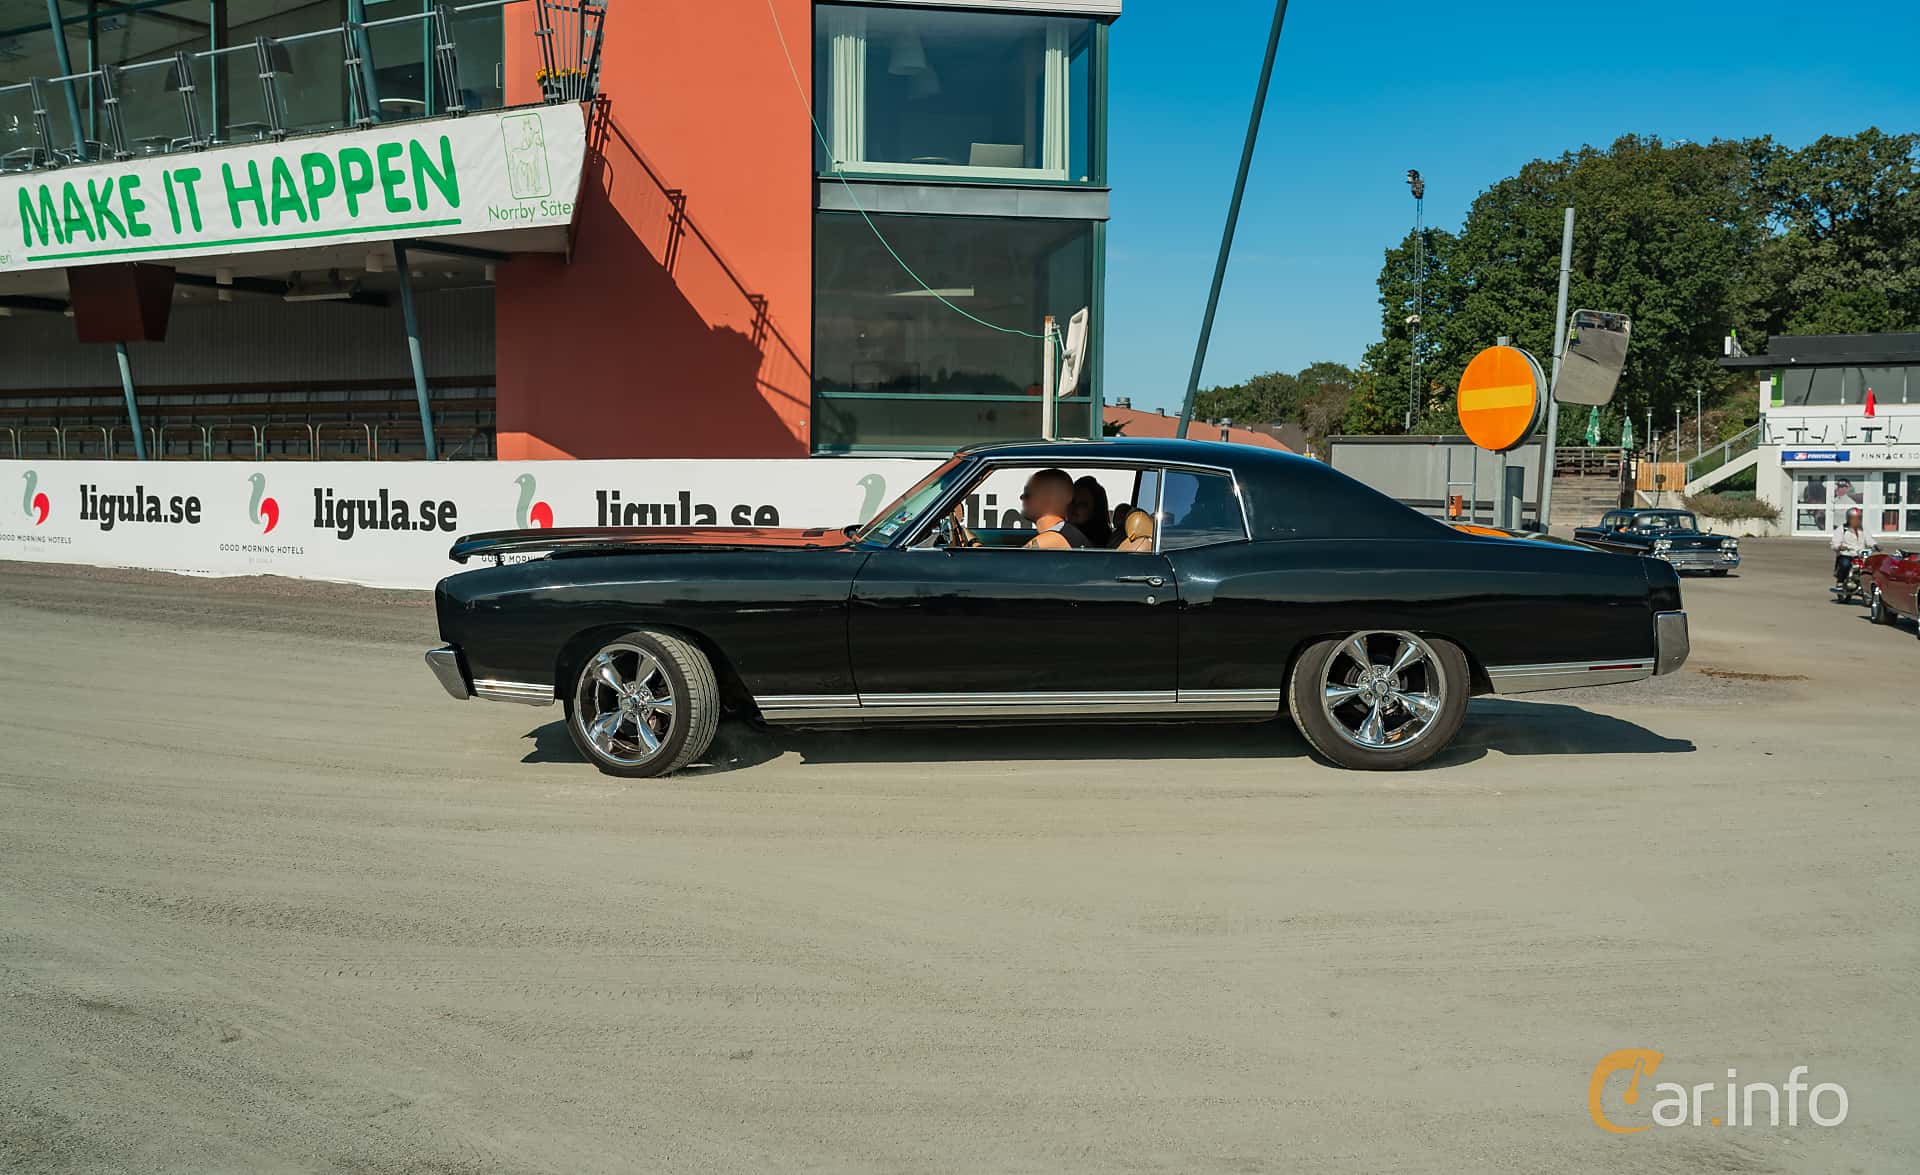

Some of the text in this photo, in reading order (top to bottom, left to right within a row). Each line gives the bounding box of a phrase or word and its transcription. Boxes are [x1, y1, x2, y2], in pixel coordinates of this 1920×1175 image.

[18, 135, 460, 247] MAKE IT HAPPEN
[488, 201, 536, 222] Norrby
[80, 484, 201, 531] ligula.se
[314, 487, 457, 540] ligula.se
[596, 490, 780, 527] ligulase
[219, 543, 304, 555] GOOD MORNING HOTELS
